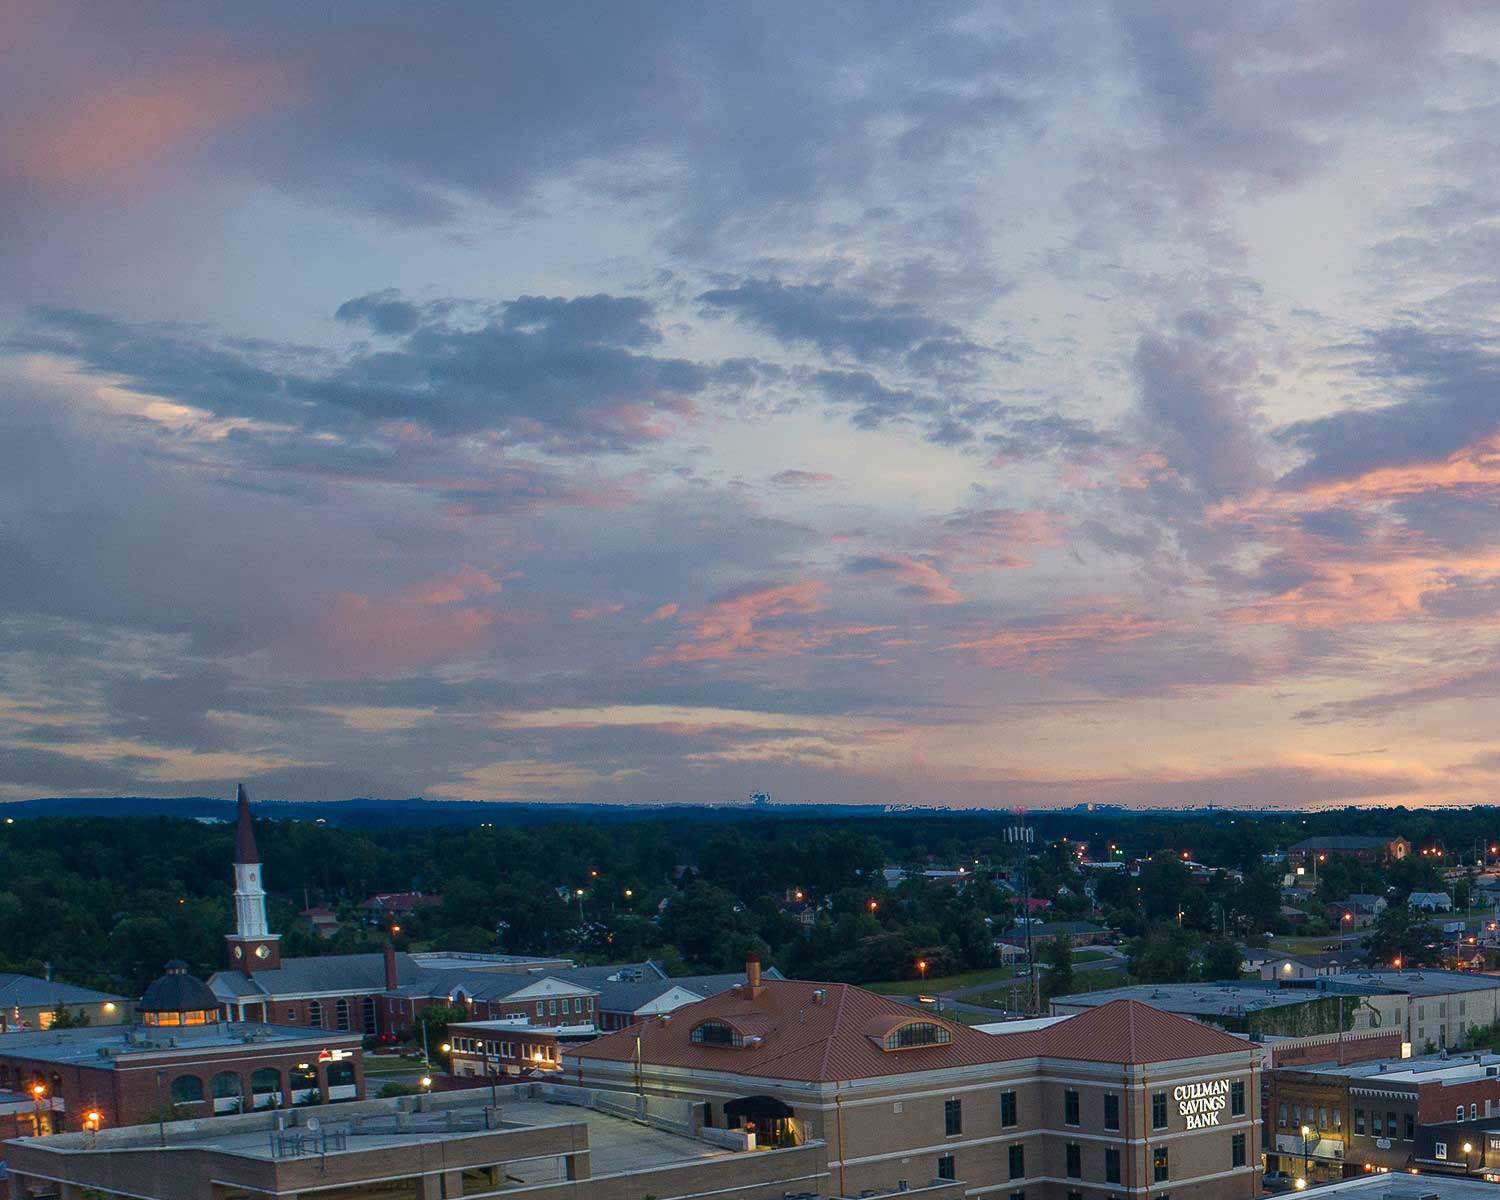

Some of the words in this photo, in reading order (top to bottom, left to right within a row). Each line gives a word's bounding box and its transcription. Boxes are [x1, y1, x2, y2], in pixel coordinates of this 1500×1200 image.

[1173, 1079, 1230, 1101] CULLMAN
[1179, 1095, 1226, 1116] SAVINGS
[1186, 1111, 1220, 1130] BANK
